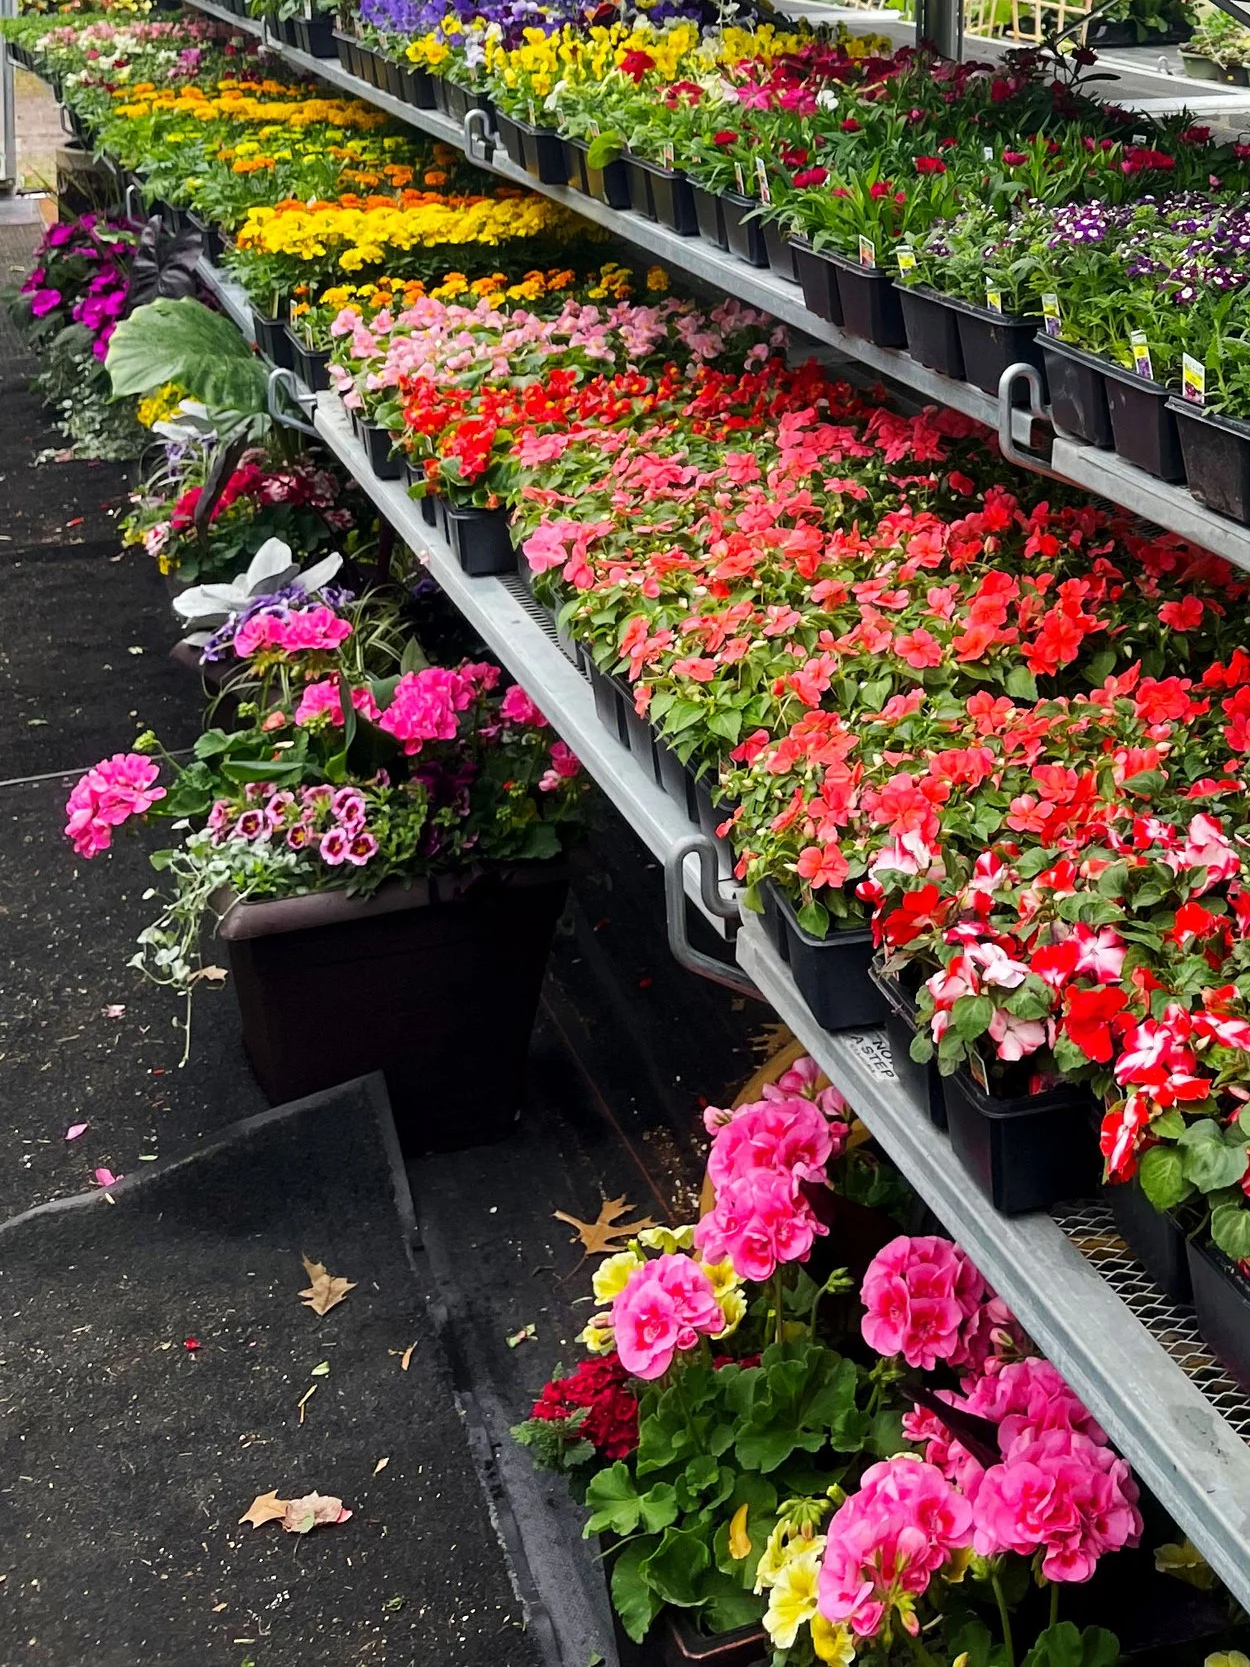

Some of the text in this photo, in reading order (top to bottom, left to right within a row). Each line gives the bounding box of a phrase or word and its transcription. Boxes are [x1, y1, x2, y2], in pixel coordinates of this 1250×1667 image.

[851, 1036, 864, 1045] A
[861, 1046, 894, 1077] STEP
[872, 1041, 893, 1064] NO
